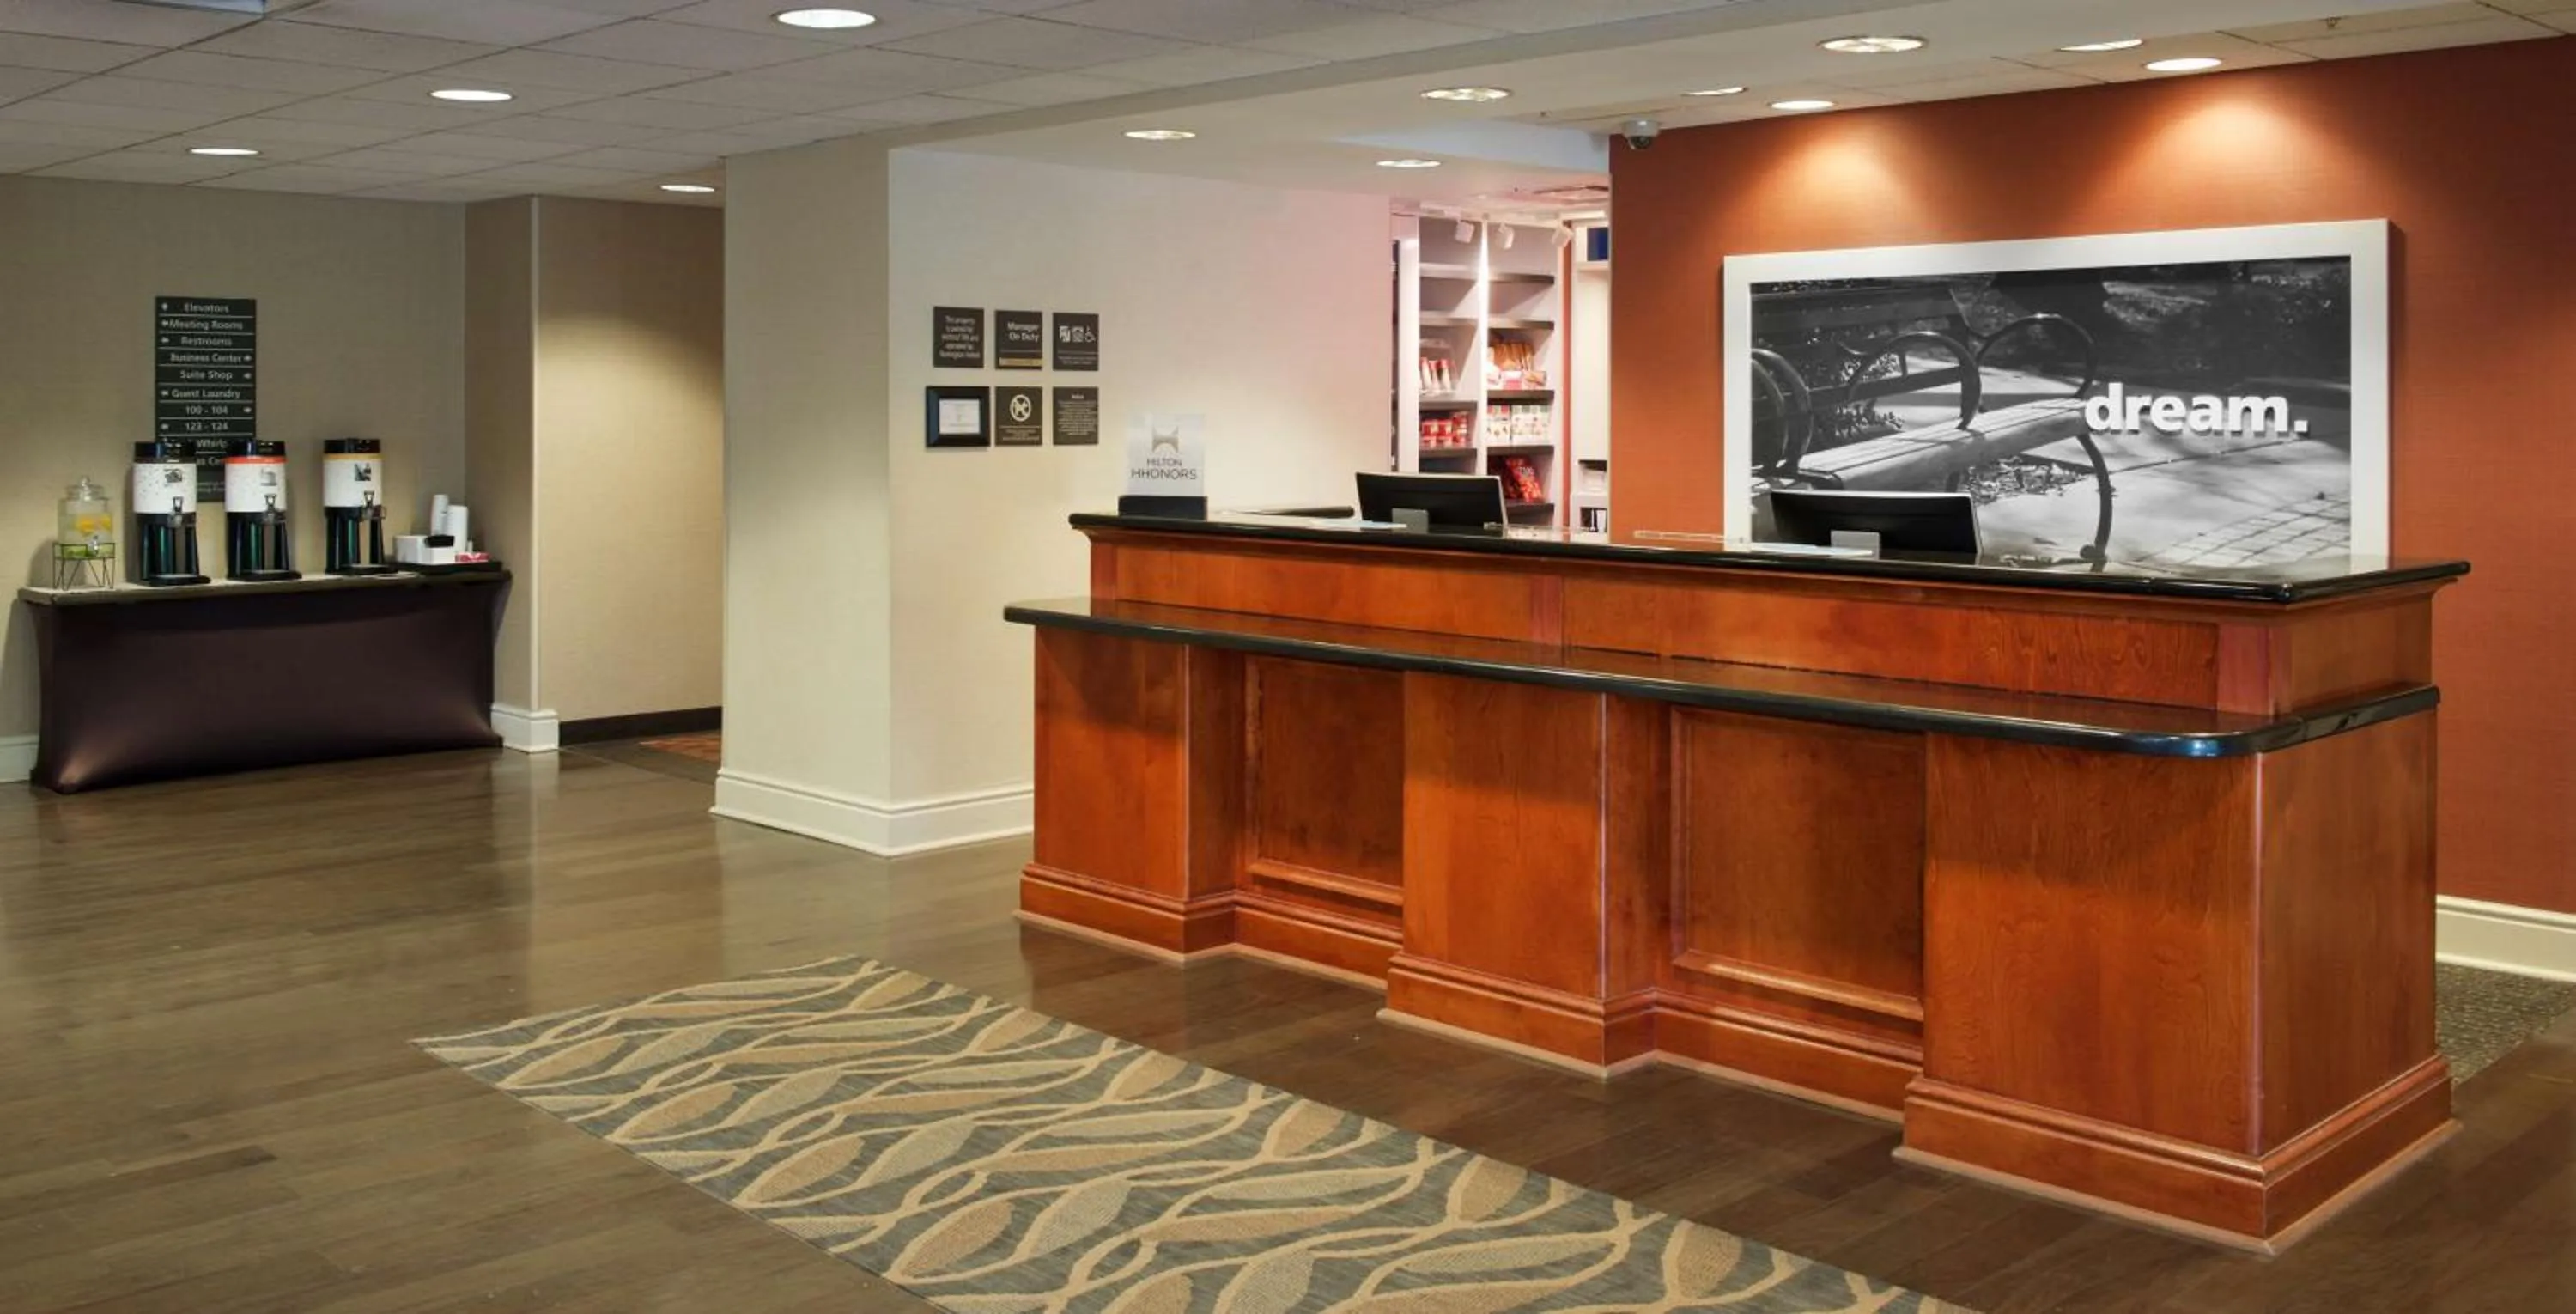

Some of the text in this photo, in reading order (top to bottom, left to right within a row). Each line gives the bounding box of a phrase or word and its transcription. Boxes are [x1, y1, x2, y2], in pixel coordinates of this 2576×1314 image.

[184, 303, 229, 313] Elevators
[170, 319, 243, 330] Meeting Rooms
[1007, 321, 1038, 332] Manager
[181, 336, 232, 346] Restrooms
[1009, 332, 1039, 343] On Duty
[170, 353, 241, 362] Business Center
[180, 369, 233, 380] Suite Shop
[172, 388, 240, 398] Guest Laundry
[2084, 382, 2308, 433] dream.
[1146, 457, 1182, 466] HILTON
[1131, 468, 1198, 480] HHONORS
